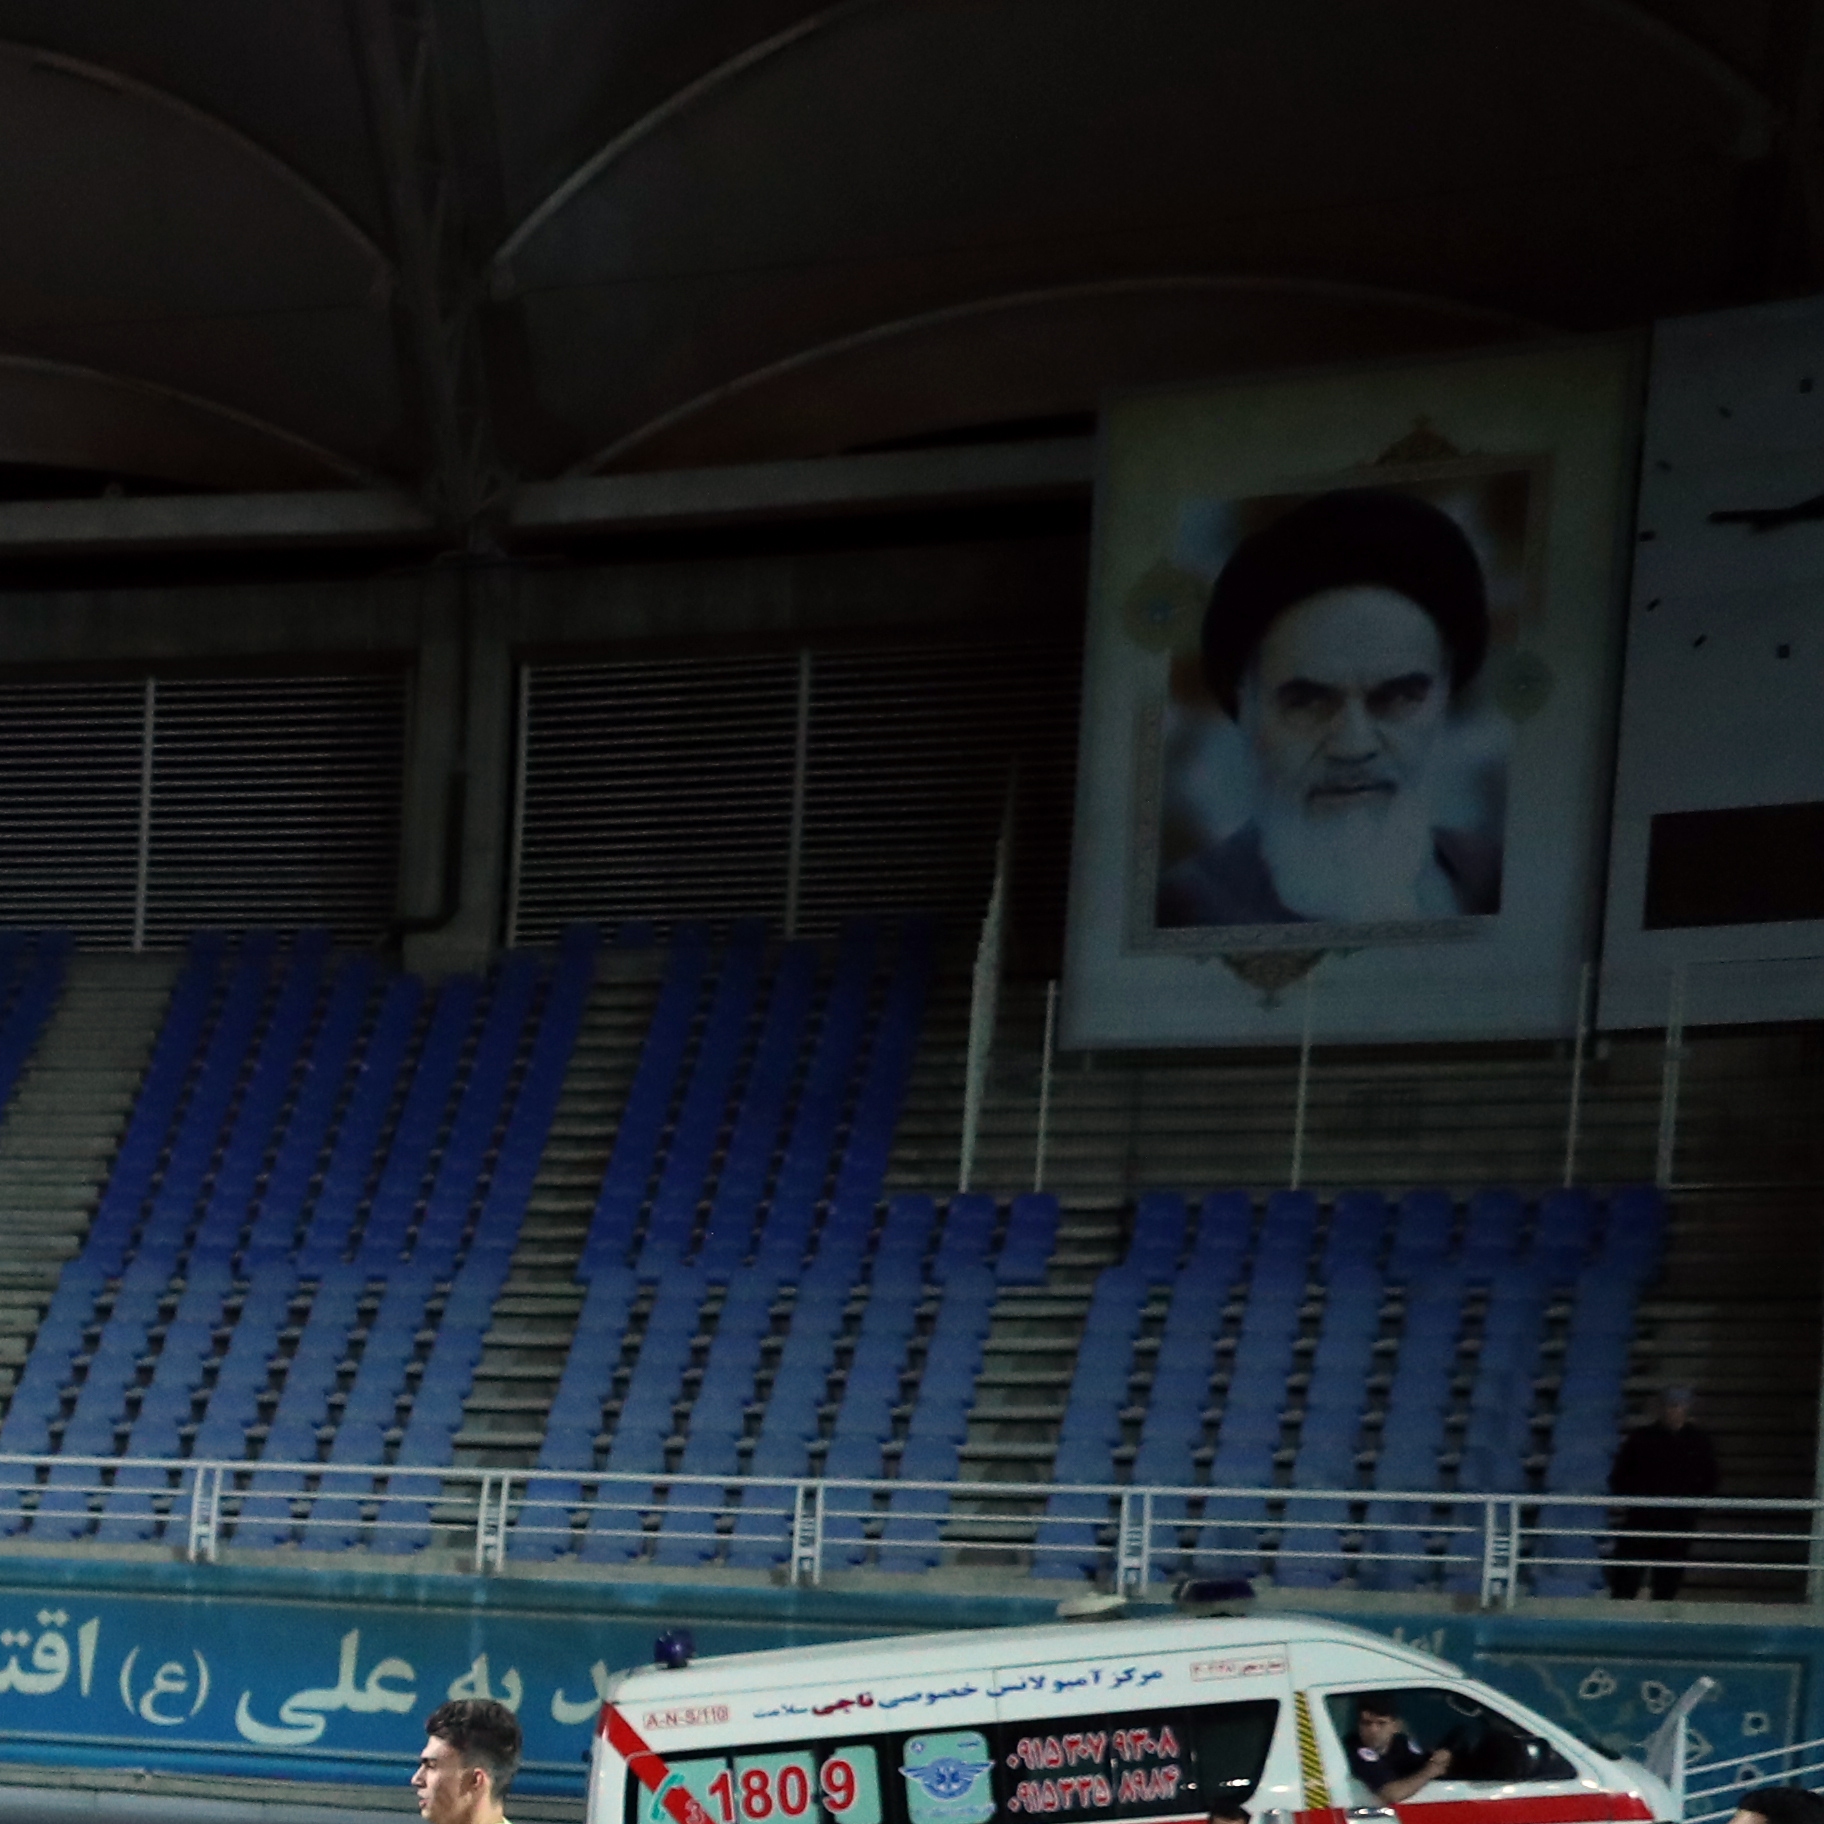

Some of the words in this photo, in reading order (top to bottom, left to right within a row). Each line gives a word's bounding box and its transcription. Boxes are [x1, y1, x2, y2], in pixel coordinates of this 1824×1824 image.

[235, 1628, 418, 1746] علی
[1109, 1665, 1164, 1689] مرکز
[878, 1682, 978, 1710] خصوصی
